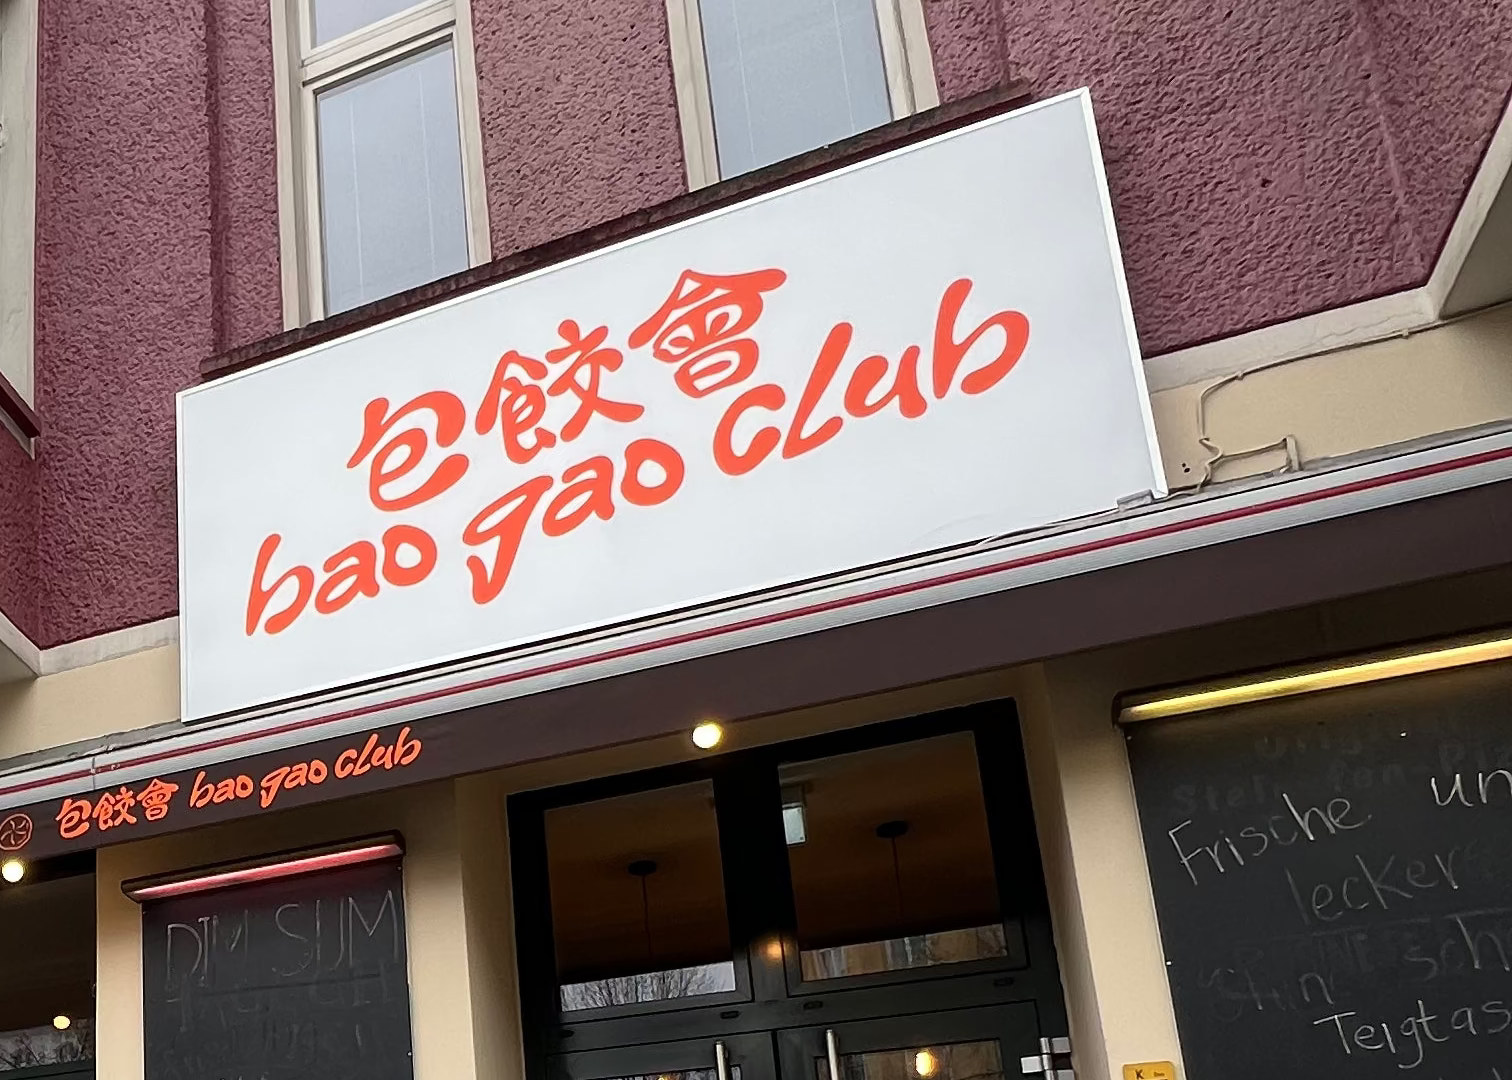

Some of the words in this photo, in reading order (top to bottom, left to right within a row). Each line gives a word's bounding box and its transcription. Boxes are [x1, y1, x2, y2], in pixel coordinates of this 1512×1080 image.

[346, 268, 788, 514] 包餃會
[245, 524, 438, 636] bao
[462, 437, 686, 606] gao
[713, 277, 1031, 477] club
[56, 779, 180, 840] 包餃會
[189, 771, 254, 808] bao
[260, 759, 328, 808] gao
[334, 726, 422, 779] club
[1168, 793, 1372, 886] Frische
[166, 908, 250, 988] DIM
[272, 889, 400, 977] SUM
[1135, 1069, 1145, 1080] K
